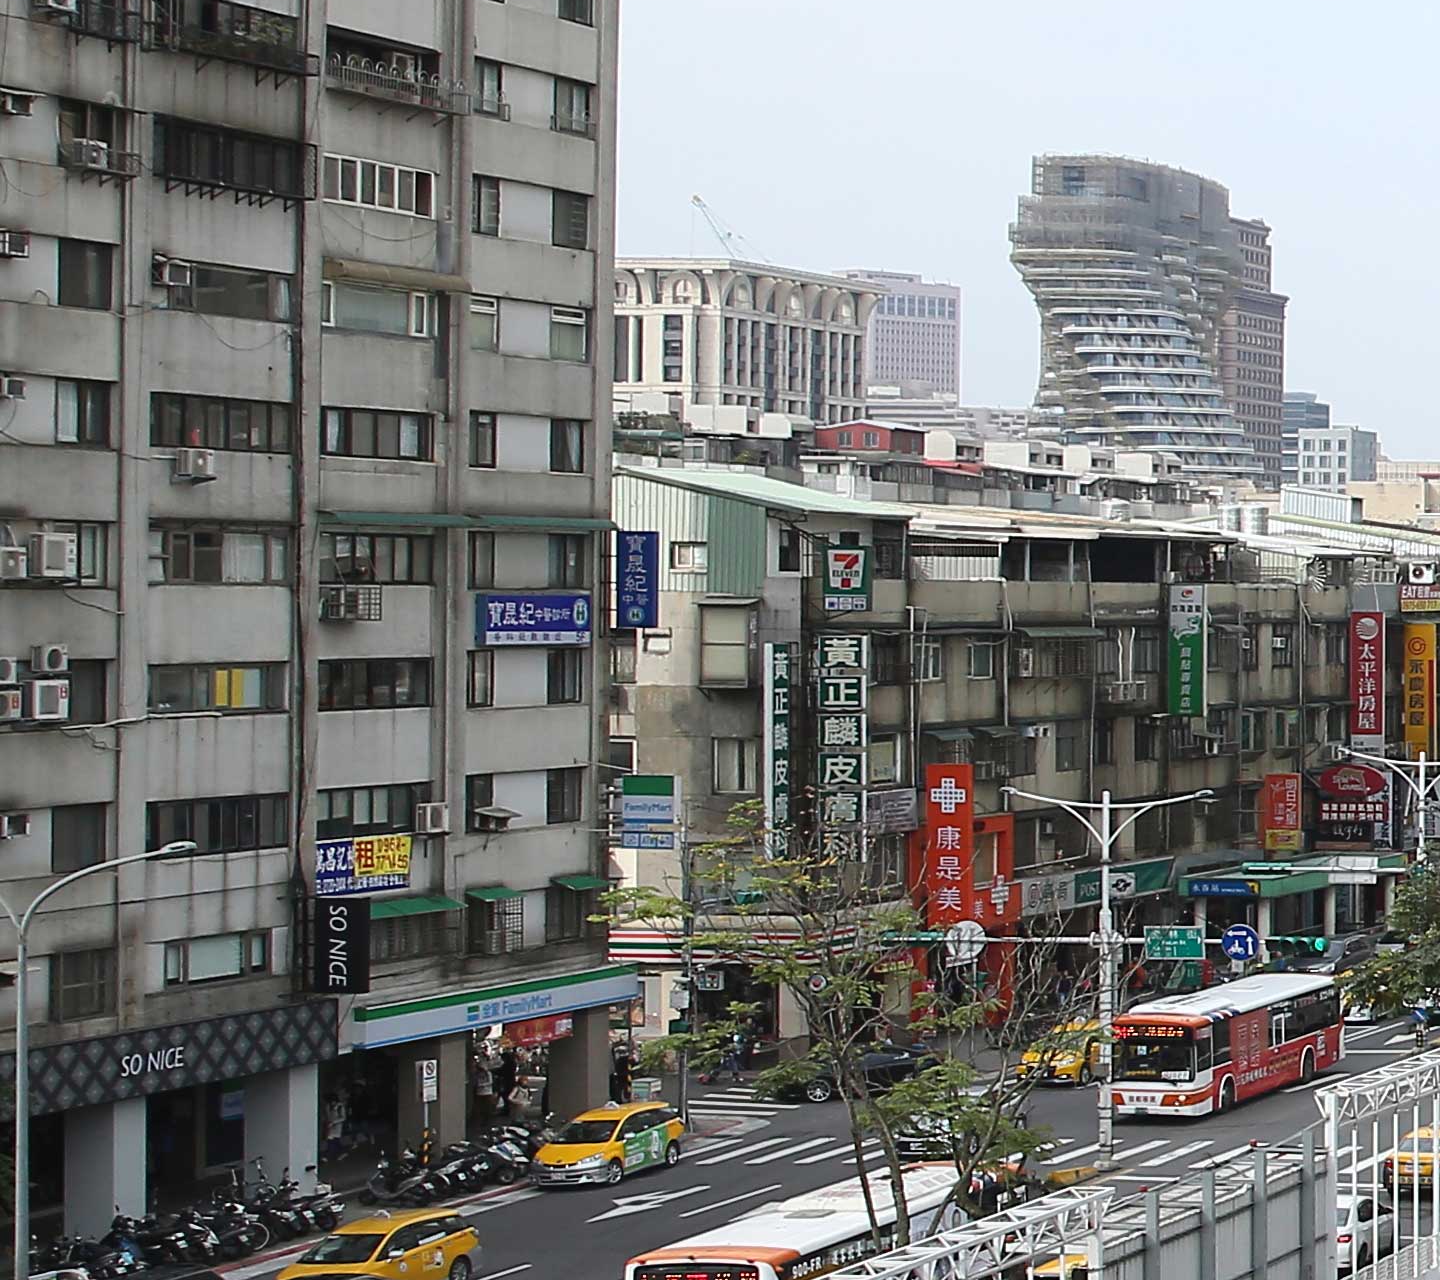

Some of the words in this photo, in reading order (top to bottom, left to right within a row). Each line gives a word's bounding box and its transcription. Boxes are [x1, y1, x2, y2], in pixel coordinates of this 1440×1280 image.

[1358, 643, 1377, 730] 太平洋房屋
[356, 840, 375, 868] 租
[936, 825, 961, 911] 康是美
[329, 905, 348, 932] SO
[329, 938, 348, 987] NICE
[501, 993, 553, 1017] FamilyMart
[121, 1054, 143, 1079] SO
[146, 1045, 186, 1074] NICE
[791, 1256, 823, 1280] 900-FR
